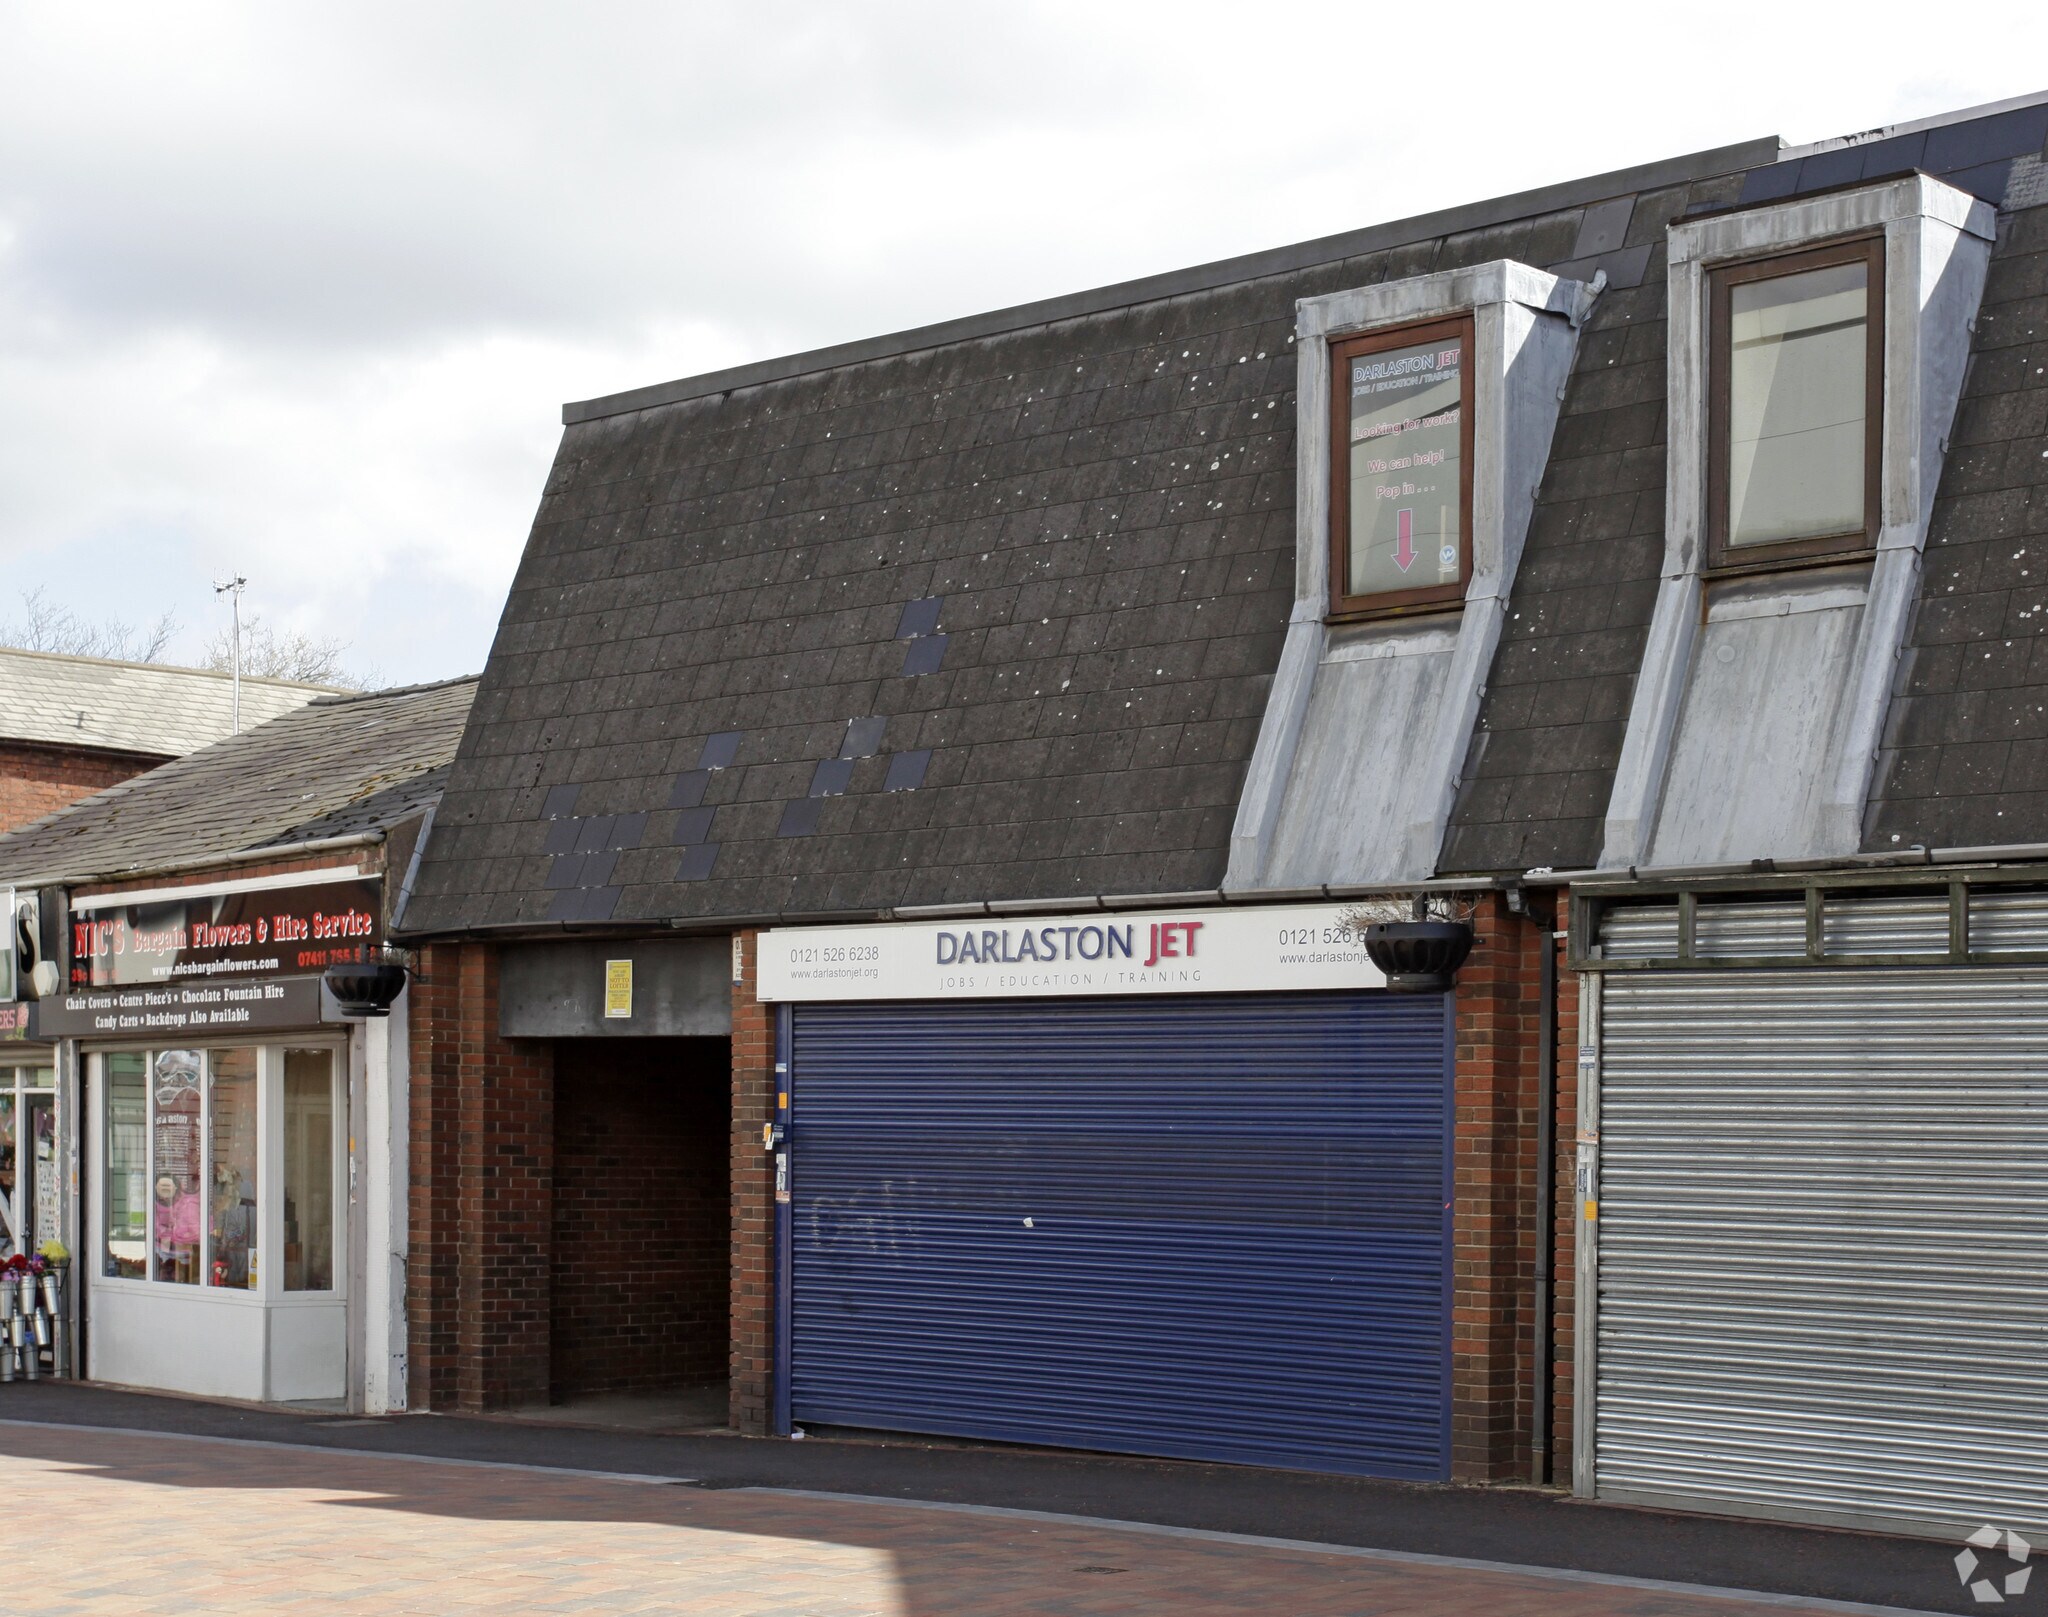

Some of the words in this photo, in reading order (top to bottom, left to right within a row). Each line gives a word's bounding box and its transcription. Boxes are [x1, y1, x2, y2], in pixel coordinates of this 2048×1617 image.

[1353, 354, 1434, 382] DARLASTON
[1436, 349, 1460, 370] JET
[1352, 385, 1371, 397] JOBS
[1376, 376, 1418, 392] EDUCATION
[1423, 369, 1459, 383] TRAINING
[1355, 422, 1402, 439] Looking
[1401, 418, 1421, 431] for
[1422, 410, 1459, 427] work?
[1368, 459, 1387, 473] We
[1389, 457, 1411, 470] can
[1414, 450, 1445, 466] help!
[1376, 485, 1399, 499] Pop
[1403, 482, 1415, 495] in
[74, 919, 125, 958] NIC'S
[133, 925, 187, 956] Bargain
[192, 921, 251, 948] Flowers
[256, 916, 268, 943] &
[272, 913, 308, 942] Hire
[312, 907, 372, 939] Service
[936, 924, 1134, 965] DARLASTON
[1144, 921, 1204, 966] JET
[1279, 928, 1315, 945] 0121
[1323, 927, 1352, 944] 526
[297, 952, 327, 968] 07411
[790, 948, 818, 963] 0121
[823, 947, 845, 962] 526
[849, 946, 879, 961] 6238
[152, 958, 279, 976] www.nicsbargainflowers.com
[790, 967, 878, 979] www.darlastonjet.org
[939, 977, 975, 990] JOBS
[1000, 974, 1092, 988] EDUCATION
[1119, 970, 1201, 984] TRAINING
[65, 998, 87, 1010] Chair
[88, 997, 111, 1009] Covers
[119, 994, 143, 1007] Centre
[145, 991, 172, 1006] Piece's
[182, 988, 221, 1003] Chocolate
[223, 985, 262, 1001] Fountain
[264, 984, 285, 999] Hire
[95, 1015, 117, 1030] Candy
[119, 1014, 139, 1027] Carts
[146, 1011, 187, 1027] Backdrops
[189, 1009, 207, 1023] Also
[210, 1007, 250, 1023] Available
